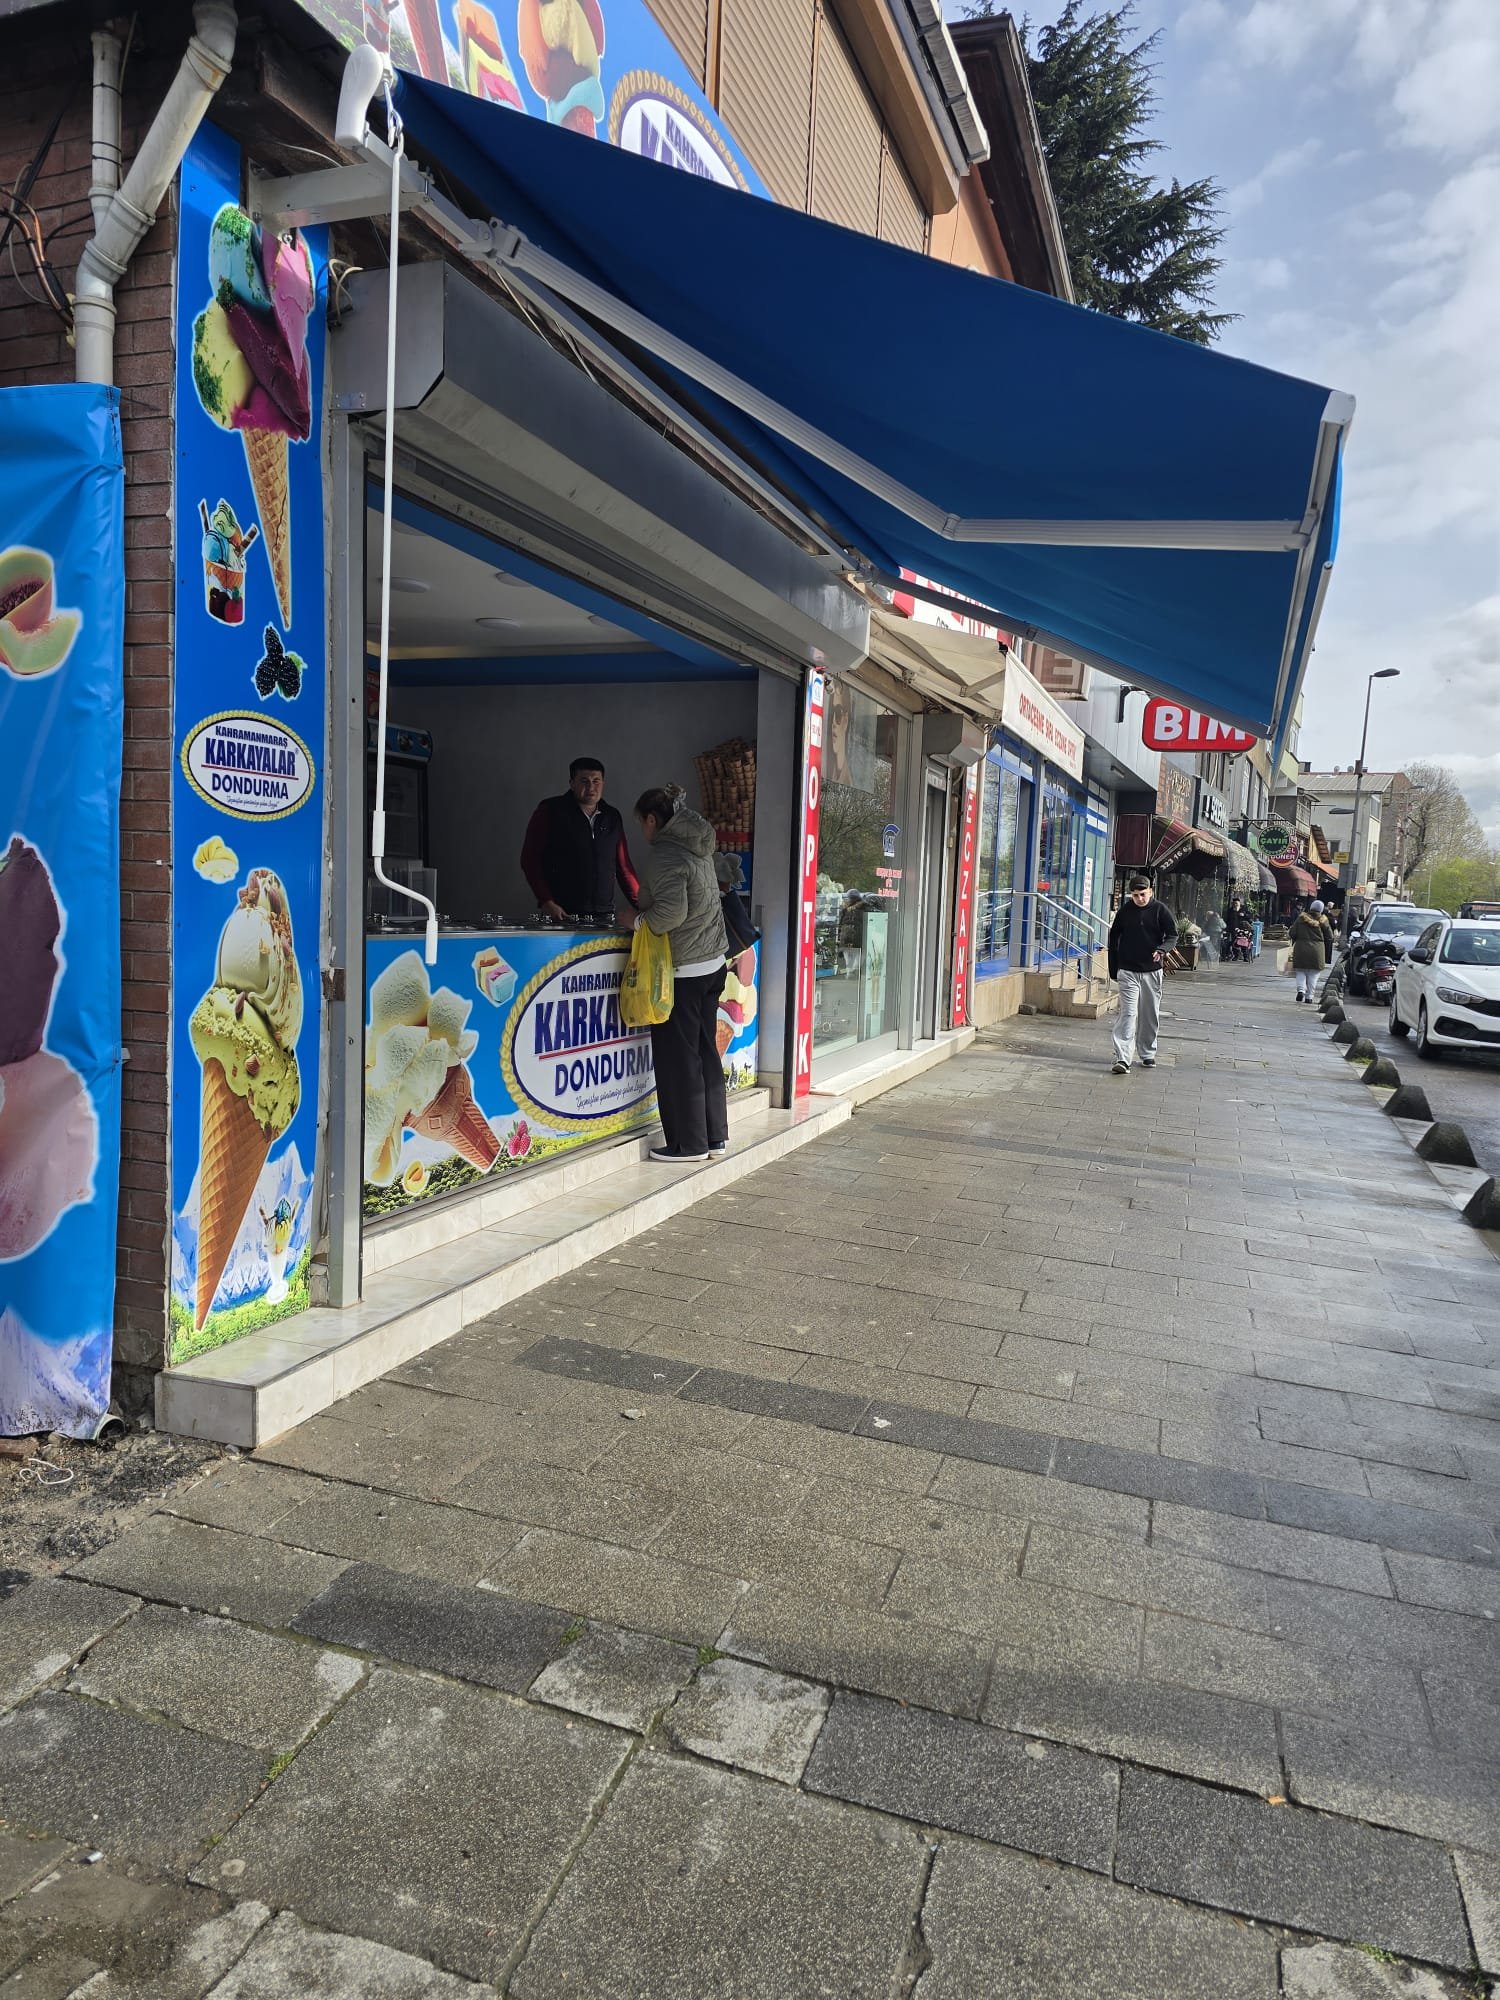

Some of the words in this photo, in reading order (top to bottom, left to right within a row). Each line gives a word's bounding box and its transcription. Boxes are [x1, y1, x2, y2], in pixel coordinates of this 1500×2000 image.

[205, 737, 296, 777] KARKAYALAR
[215, 725, 288, 749] KAHRAMANMARAŞ
[211, 772, 289, 800] DONDURMA
[798, 765, 819, 1075] OPTİK
[956, 792, 974, 1012] ECZANE
[534, 994, 651, 1055] KARKA
[555, 1045, 653, 1097] DONDURM
